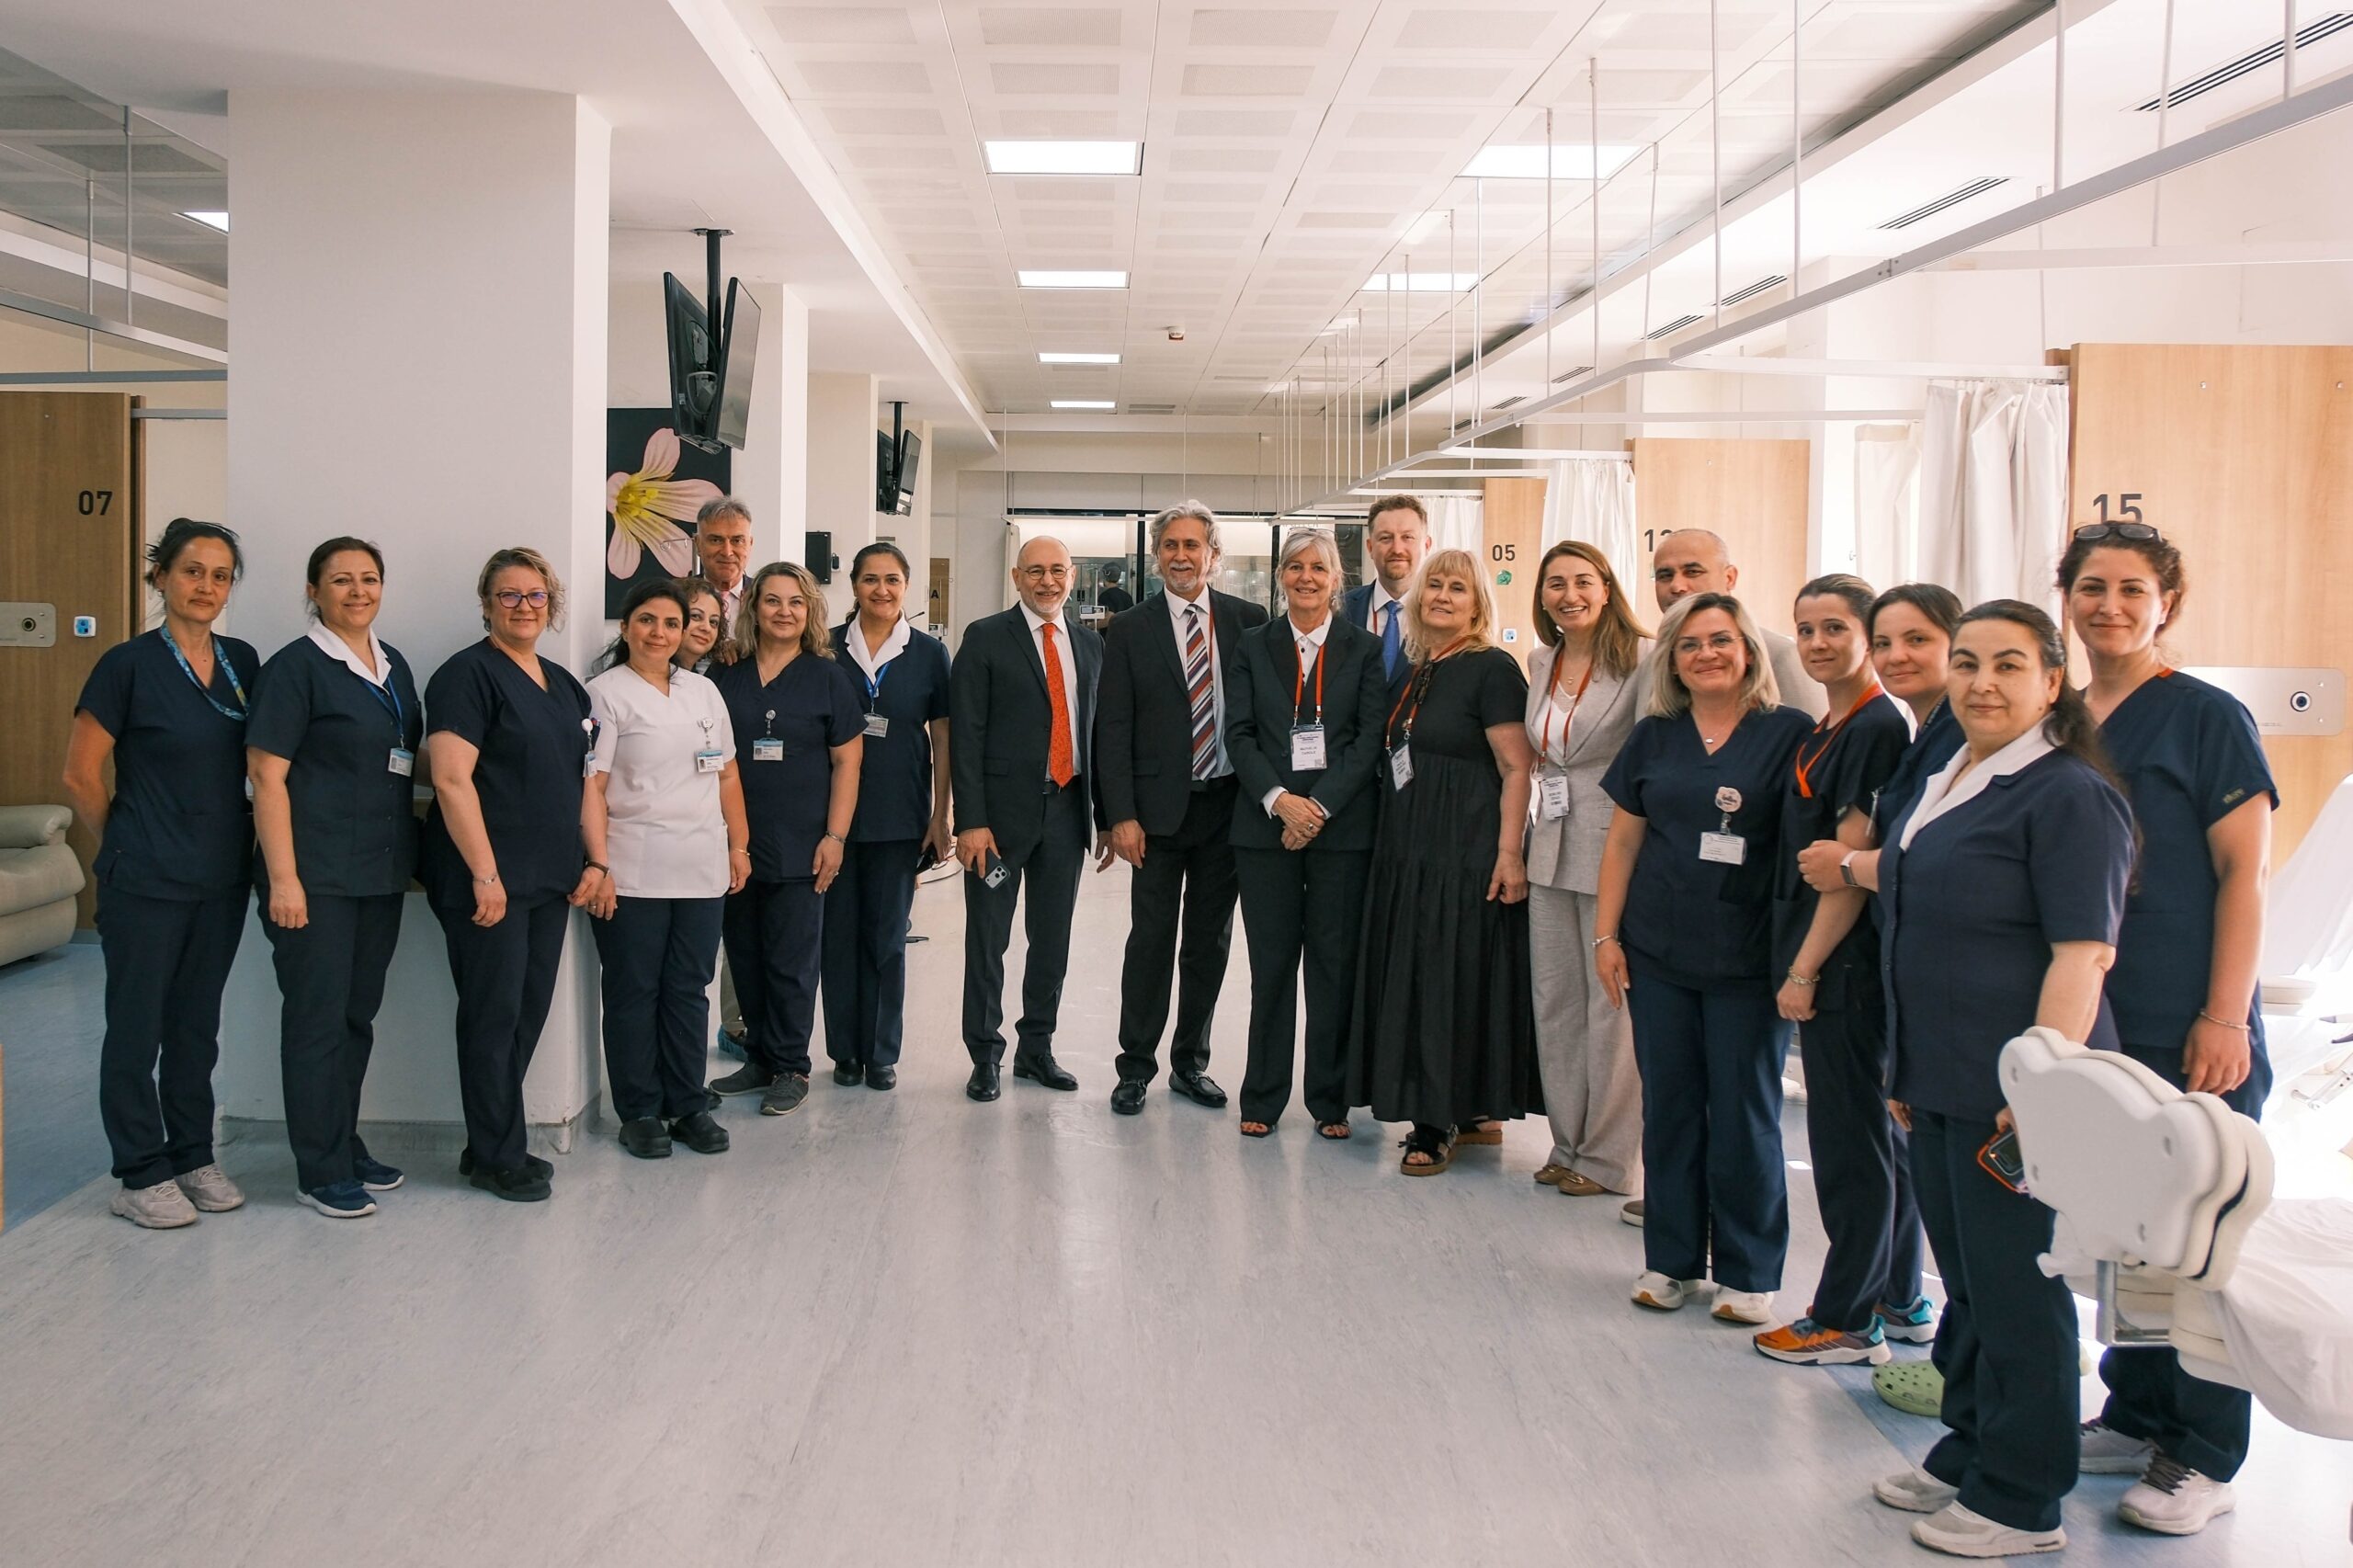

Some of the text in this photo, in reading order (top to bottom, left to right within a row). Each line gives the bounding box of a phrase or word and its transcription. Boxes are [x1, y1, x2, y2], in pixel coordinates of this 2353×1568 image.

[79, 490, 113, 516] 07
[2093, 493, 2143, 524] 15
[1492, 544, 1516, 562] 05
[930, 589, 939, 598] A
